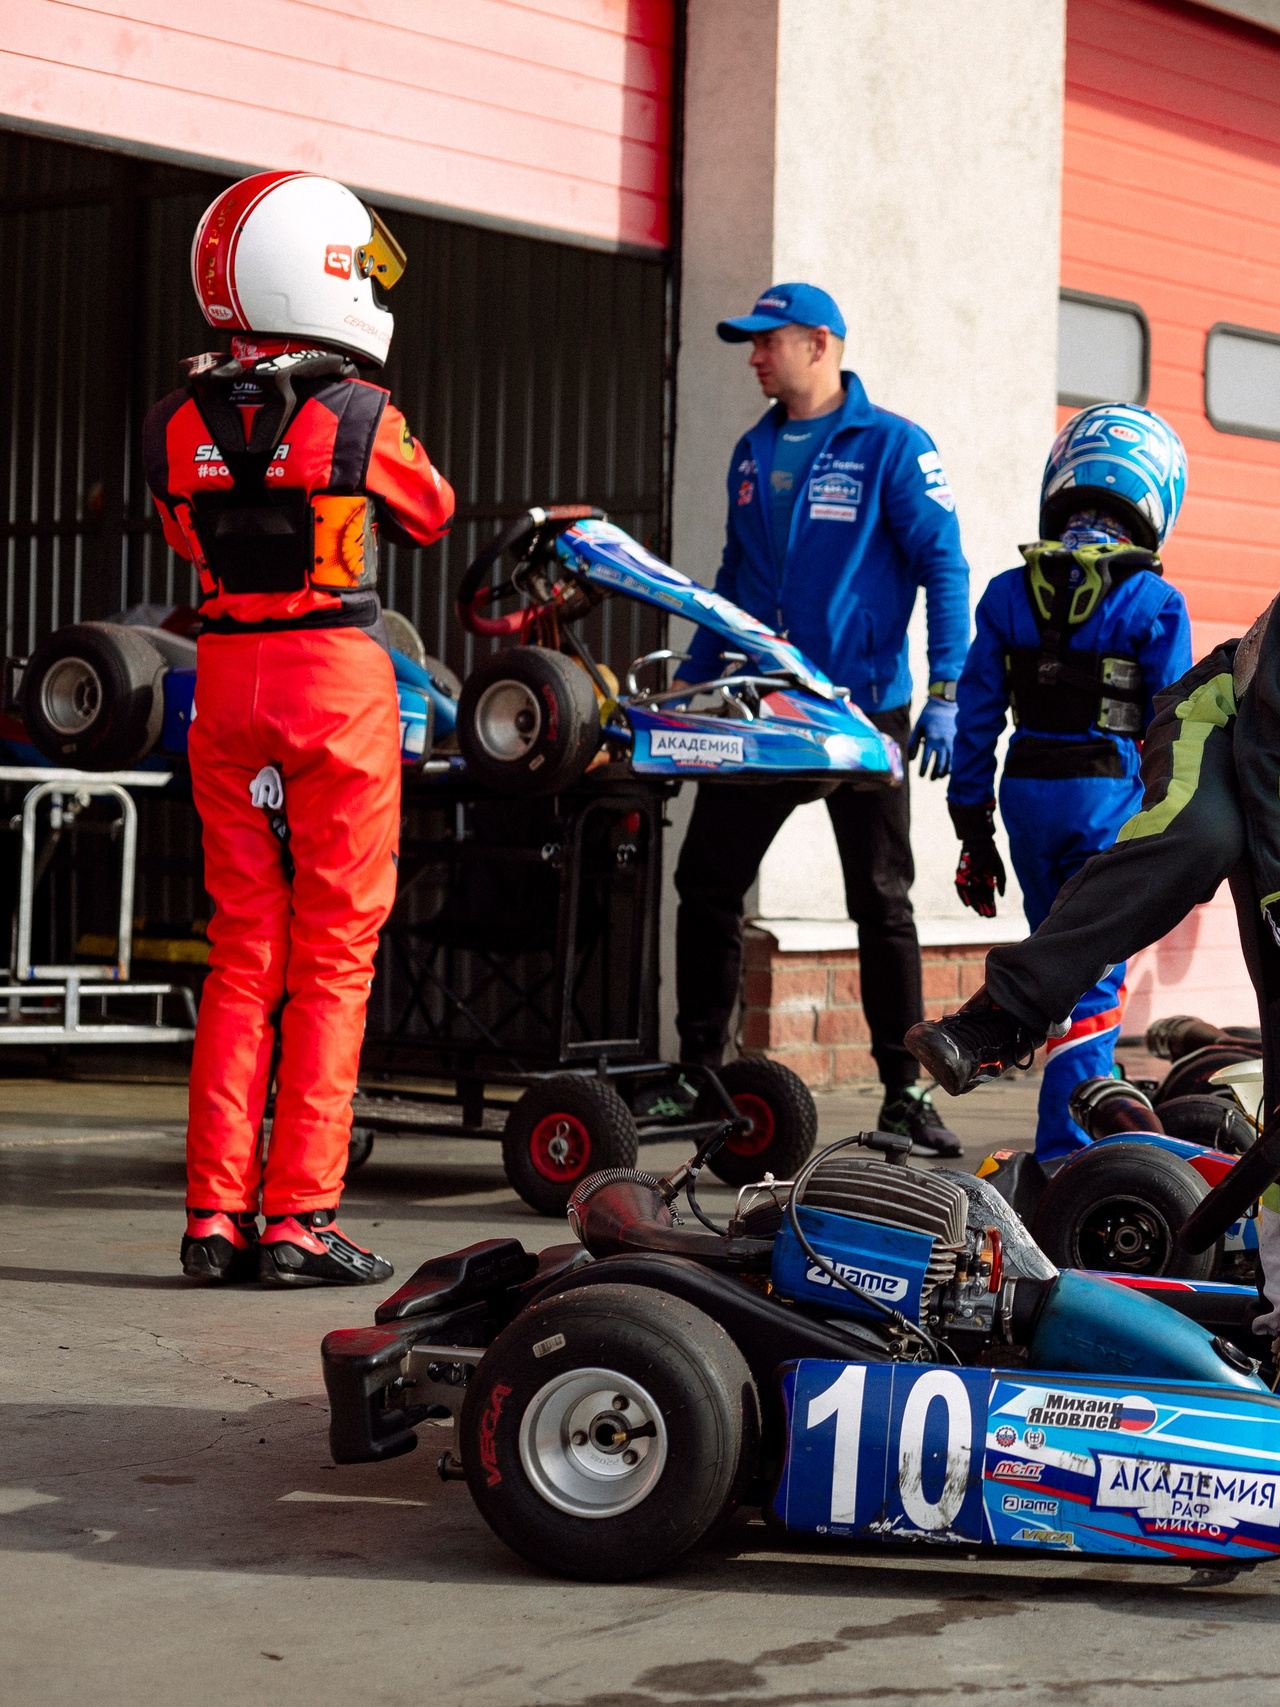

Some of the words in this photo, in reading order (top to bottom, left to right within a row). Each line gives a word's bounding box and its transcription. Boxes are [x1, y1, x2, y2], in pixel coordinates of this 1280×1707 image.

[193, 443, 292, 462] SEA
[657, 736, 739, 755] АКАДЕМИЯ
[1046, 1394, 1124, 1415] Михаил
[1028, 1407, 1121, 1430] Яковлев
[480, 1384, 513, 1486] VEGA
[807, 1365, 972, 1531] 10
[1110, 1464, 1277, 1509] АКАДЕМИЯ
[1171, 1500, 1210, 1519] РАФ
[1155, 1518, 1221, 1537] МИКРО
